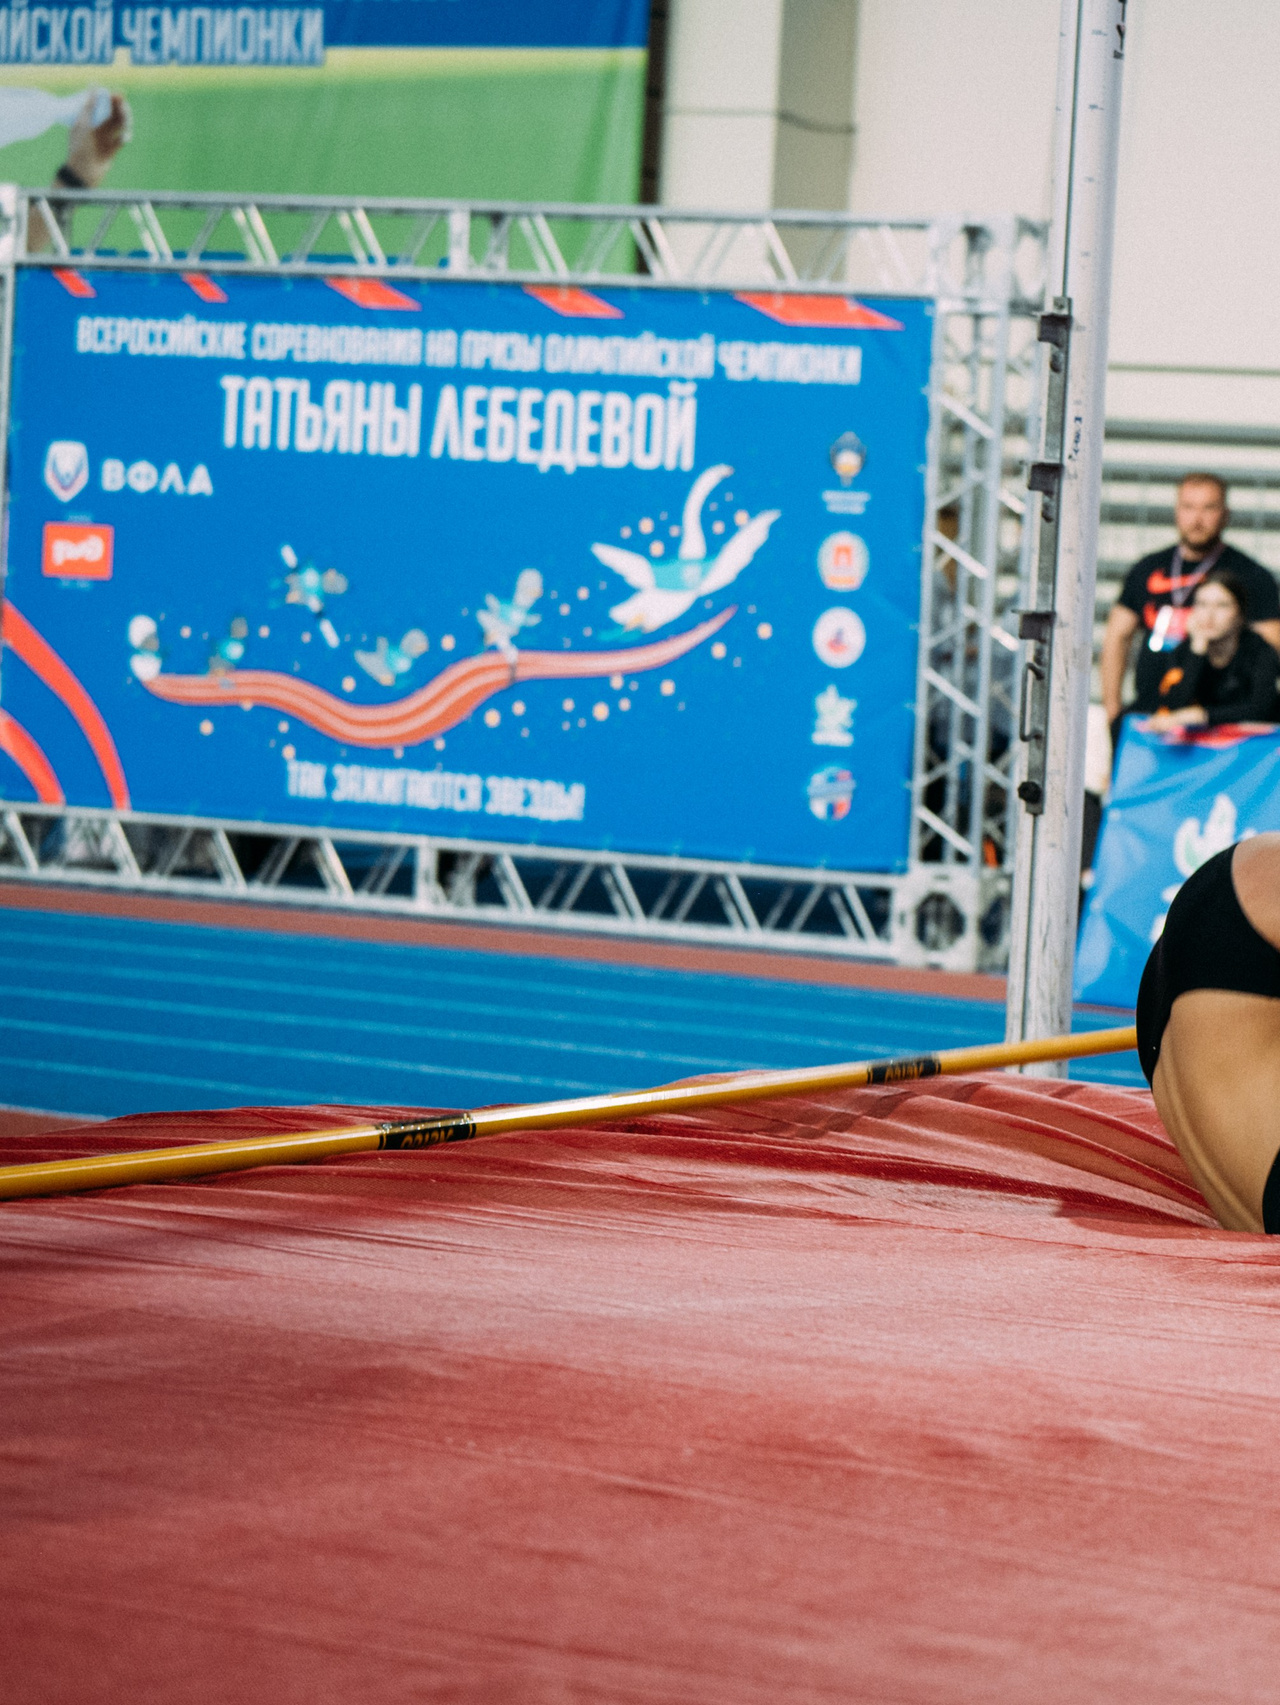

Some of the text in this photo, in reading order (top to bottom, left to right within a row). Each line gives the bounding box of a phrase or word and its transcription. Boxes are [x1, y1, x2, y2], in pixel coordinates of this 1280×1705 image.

[122, 6, 324, 63] ЧЕМПИОНКИ
[77, 313, 247, 359] ВСЕРОССИЙСКИЕ
[425, 329, 458, 367] НА
[460, 330, 542, 372] ПРИЗЫ
[718, 341, 862, 385] ЧЕМПИОНКИ
[221, 374, 698, 475] ТАТЬЯНЫ ЛЕБЕДЕВОЙ
[101, 458, 213, 496] ВФЛА
[485, 775, 585, 822] ЗВЕЗДЫ
